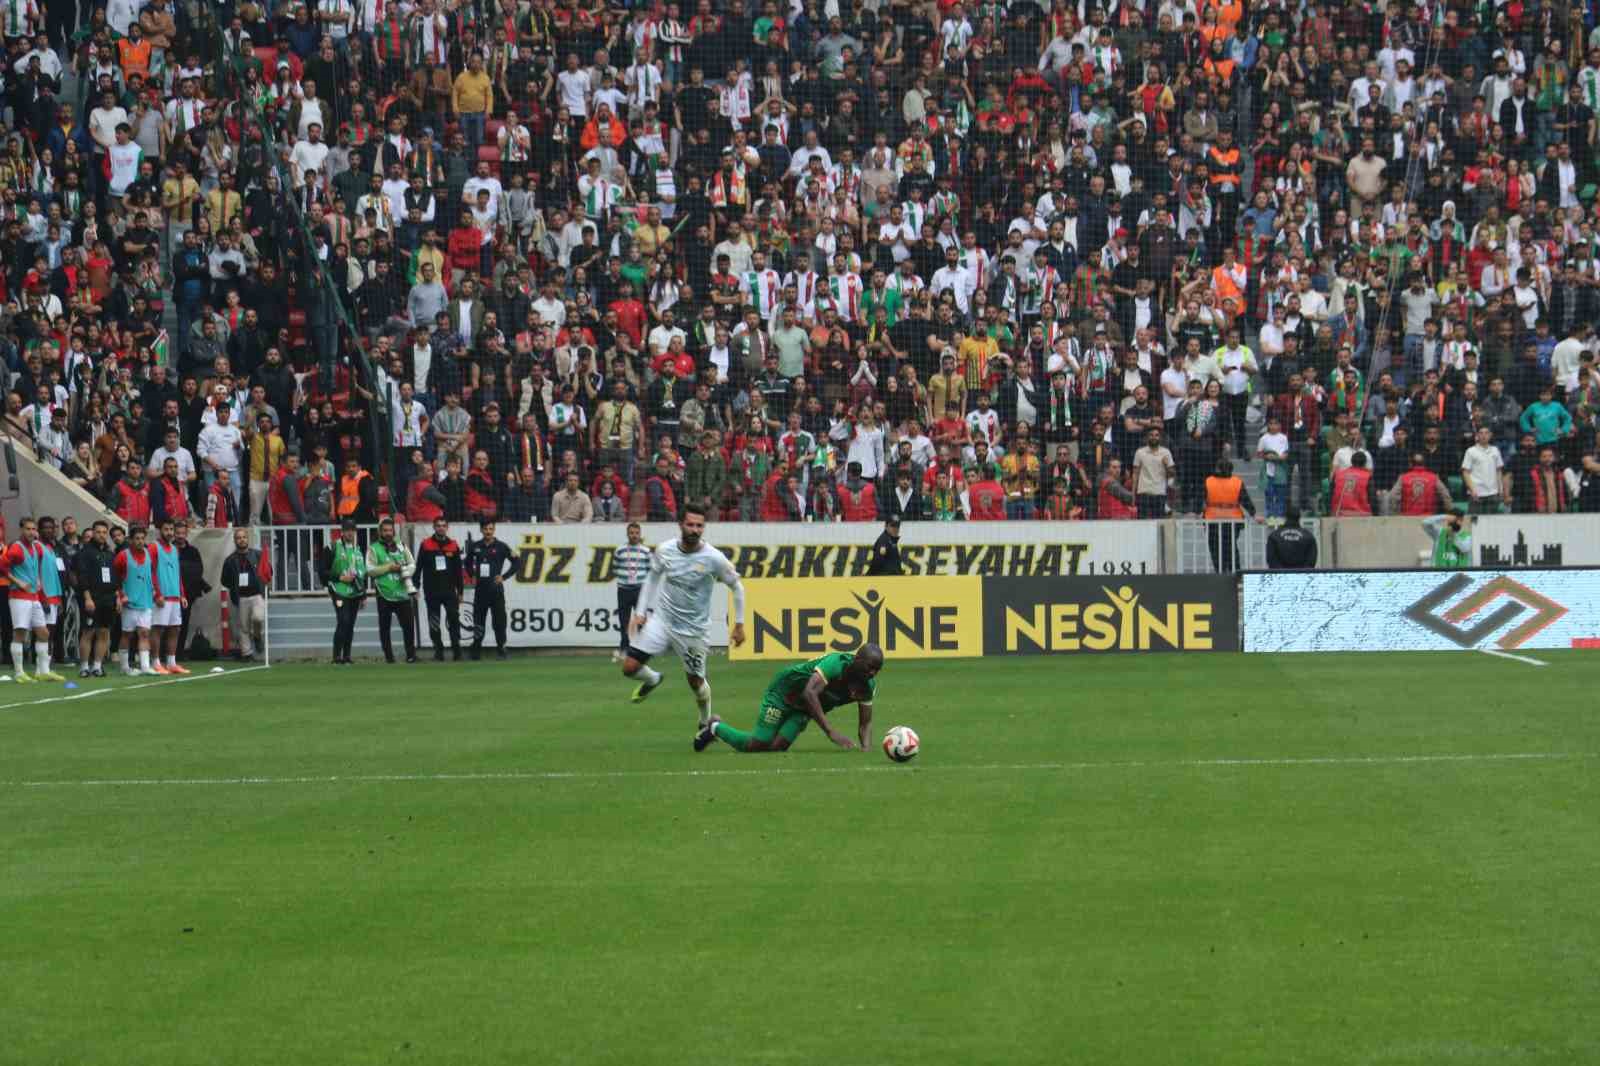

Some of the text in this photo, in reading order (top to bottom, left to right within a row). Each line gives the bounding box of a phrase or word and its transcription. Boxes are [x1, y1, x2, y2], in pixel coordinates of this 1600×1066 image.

[514, 533, 577, 585] ÖZ
[896, 544, 1089, 577] SEYAHAT
[1088, 560, 1147, 576] 1981
